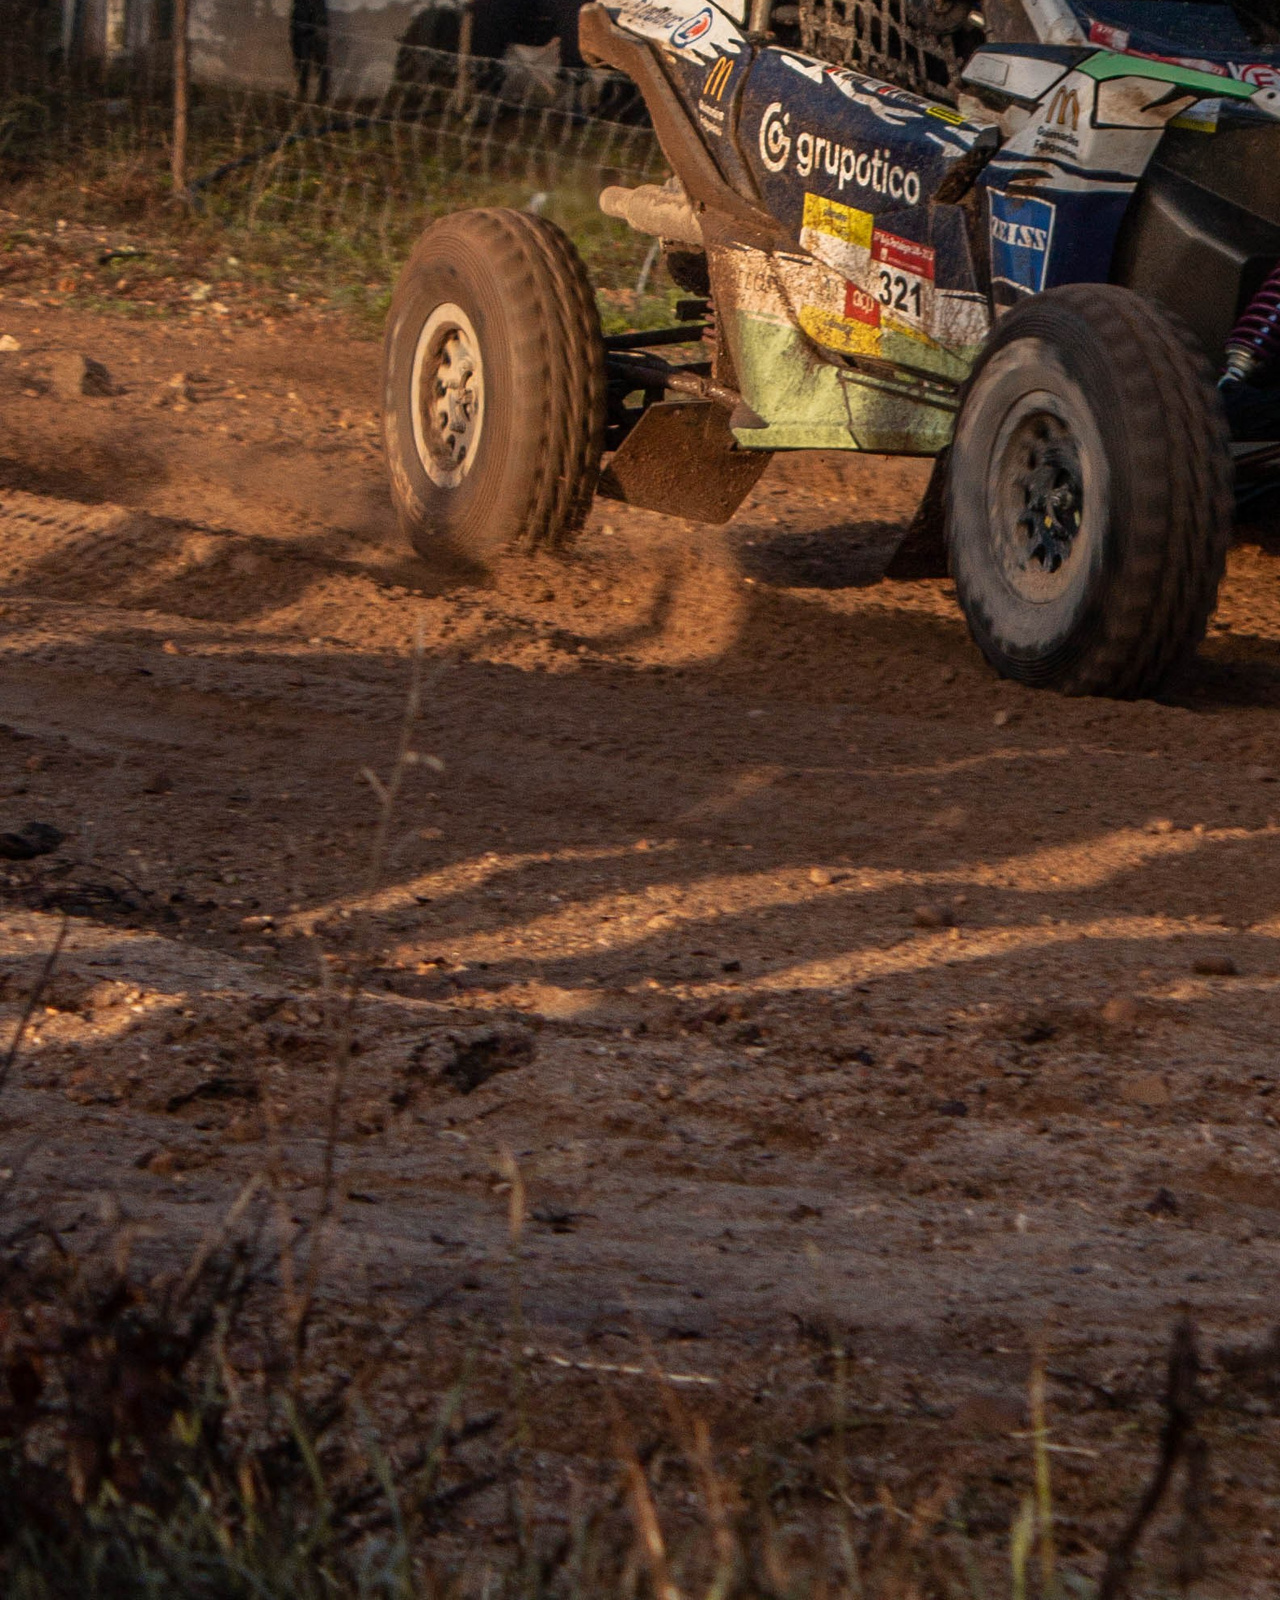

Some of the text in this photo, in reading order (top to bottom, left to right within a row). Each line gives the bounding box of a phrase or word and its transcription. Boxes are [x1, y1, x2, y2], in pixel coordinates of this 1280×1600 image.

[796, 132, 921, 205] grupotico
[852, 292, 875, 314] acp
[878, 270, 921, 317] 321
